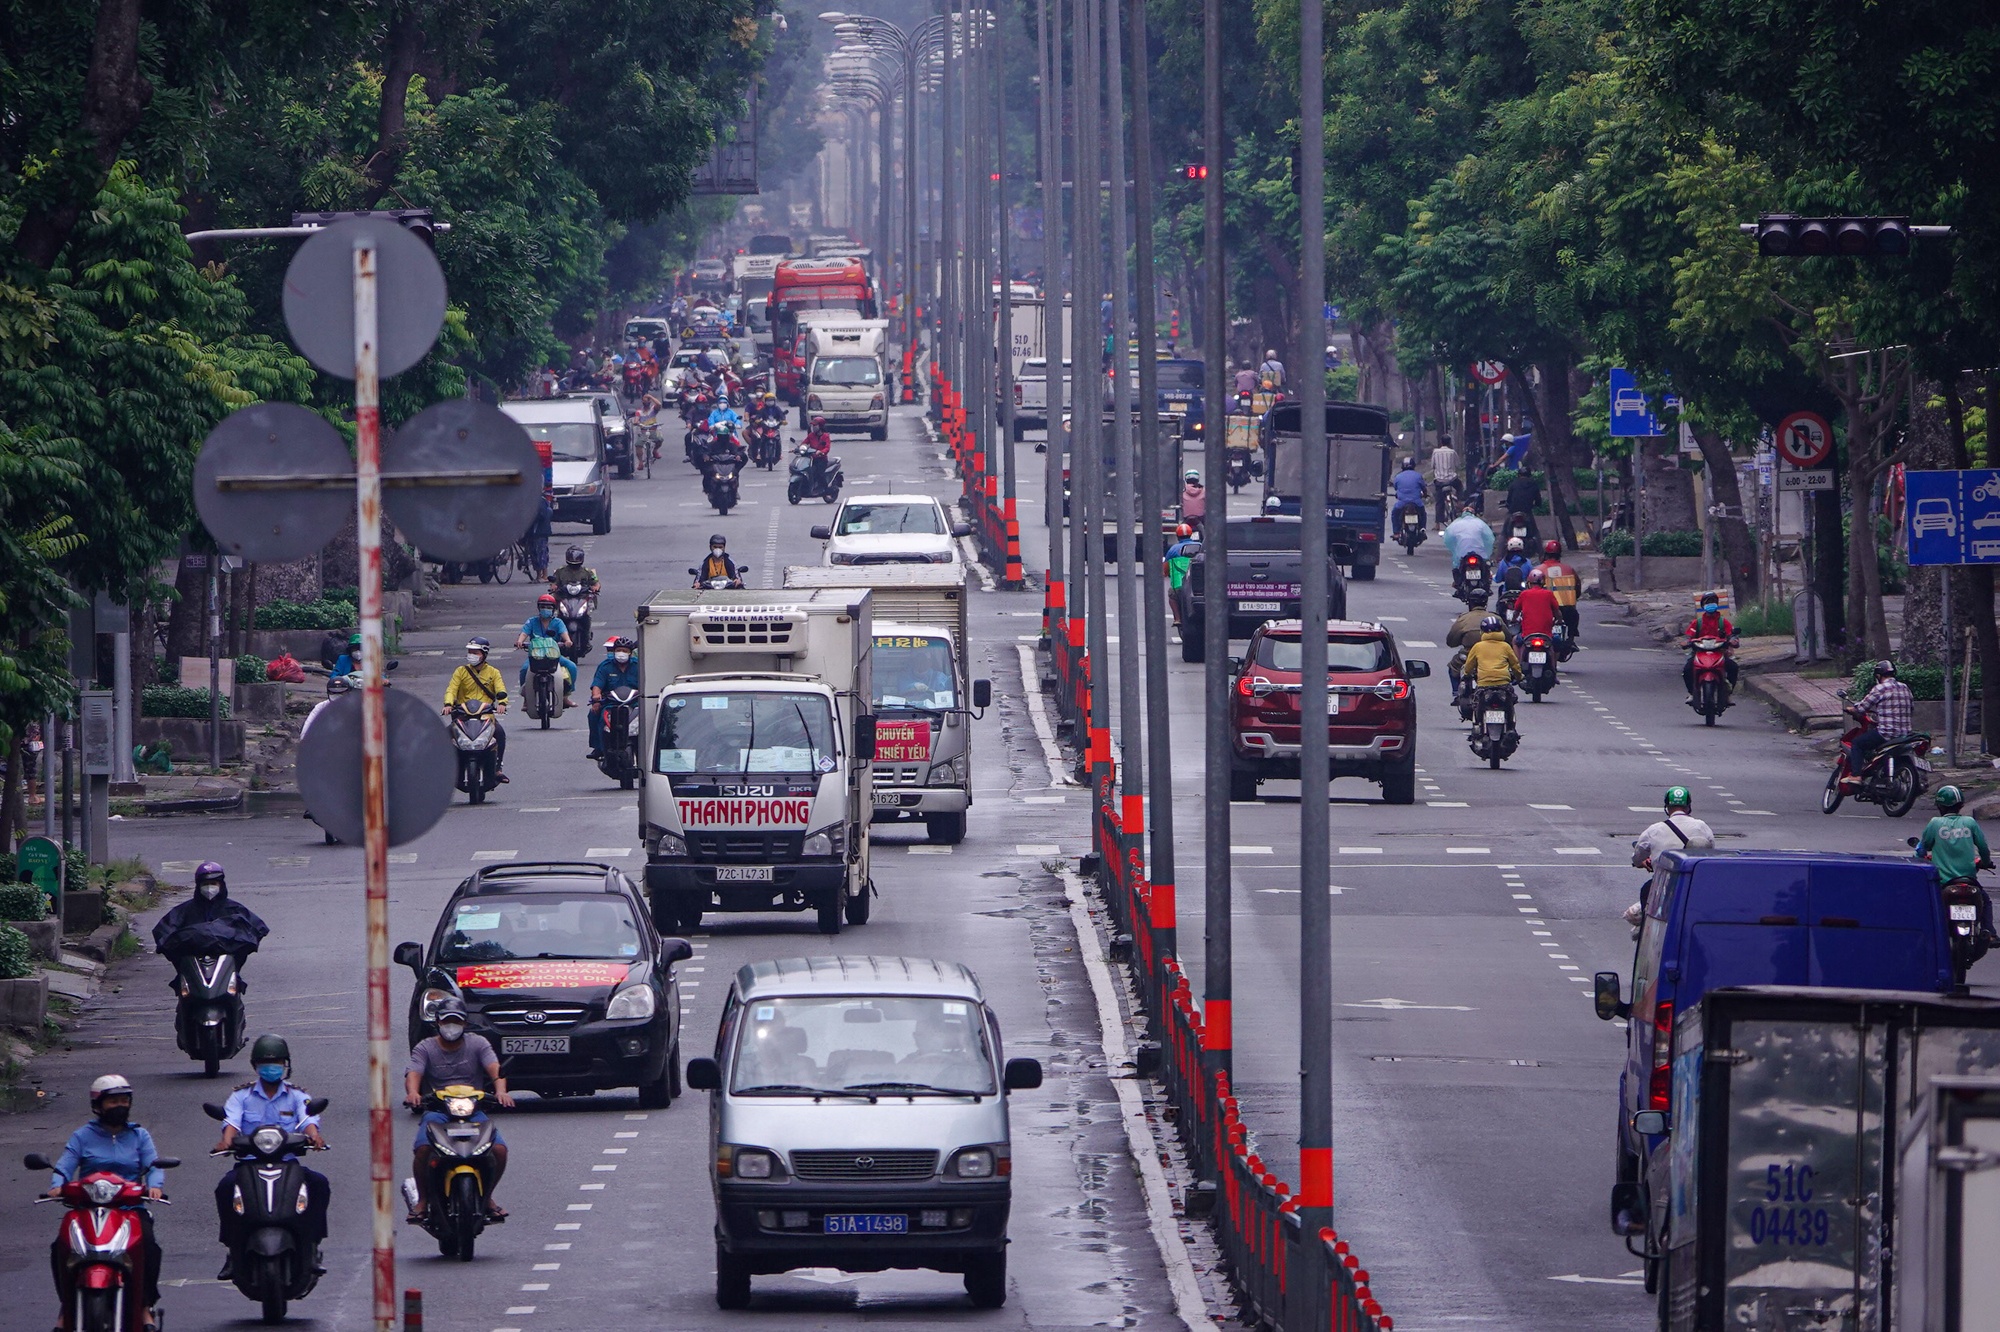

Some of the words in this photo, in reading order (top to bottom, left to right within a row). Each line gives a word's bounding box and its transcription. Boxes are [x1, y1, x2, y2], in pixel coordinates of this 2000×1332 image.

[1015, 335, 1028, 344] 51D
[1785, 477, 1800, 486] 6:00
[1808, 476, 1826, 485] 22:00
[876, 722, 915, 741] CHUYỂN
[879, 742, 905, 760] THIẾT
[907, 742, 926, 760] YẾU
[719, 785, 774, 797] ISUZU
[718, 868, 770, 880] 72C-147.31
[499, 981, 555, 989] COVID
[528, 1013, 544, 1021] KIA
[505, 1039, 566, 1053] 52F-7432
[1766, 1164, 1813, 1202] 51C
[828, 1216, 903, 1231] 51A-1498
[1750, 1207, 1829, 1246] 04439
